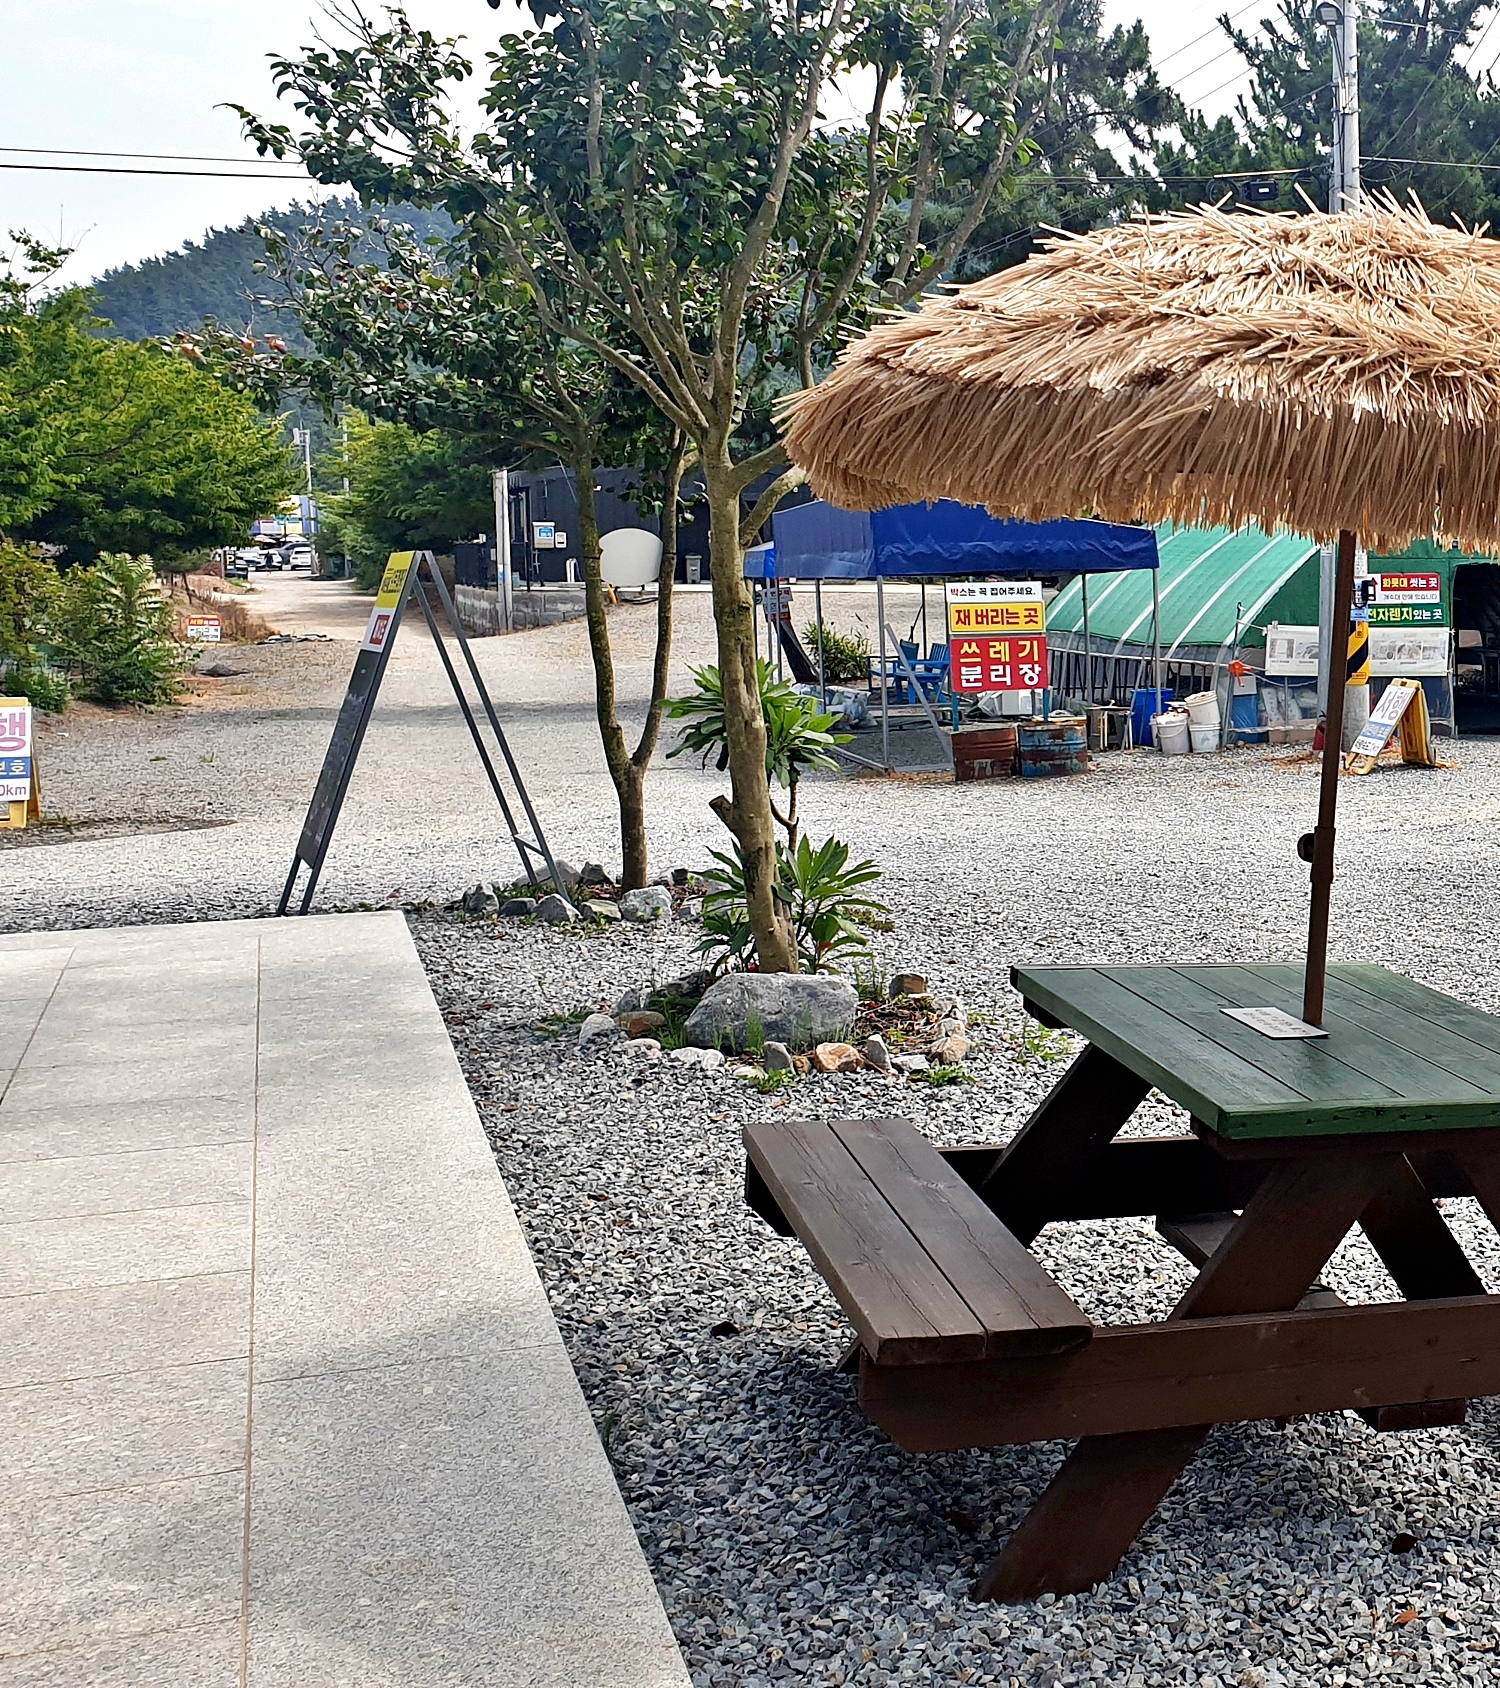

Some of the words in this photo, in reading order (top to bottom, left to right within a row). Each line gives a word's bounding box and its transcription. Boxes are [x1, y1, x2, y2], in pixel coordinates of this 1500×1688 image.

[950, 587, 977, 597] 박스는
[978, 587, 988, 597] 꼭
[990, 586, 1036, 597] 접어주세요.
[1410, 577, 1427, 588] 씻는
[1428, 577, 1438, 588] 곳
[954, 608, 971, 626] 재
[974, 608, 1021, 626] 버리는
[1023, 607, 1039, 625] 곳
[1432, 608, 1443, 620] 곳
[959, 640, 1040, 663] 쓰레기
[960, 663, 1043, 688] 분리장
[1375, 691, 1411, 720] 서행
